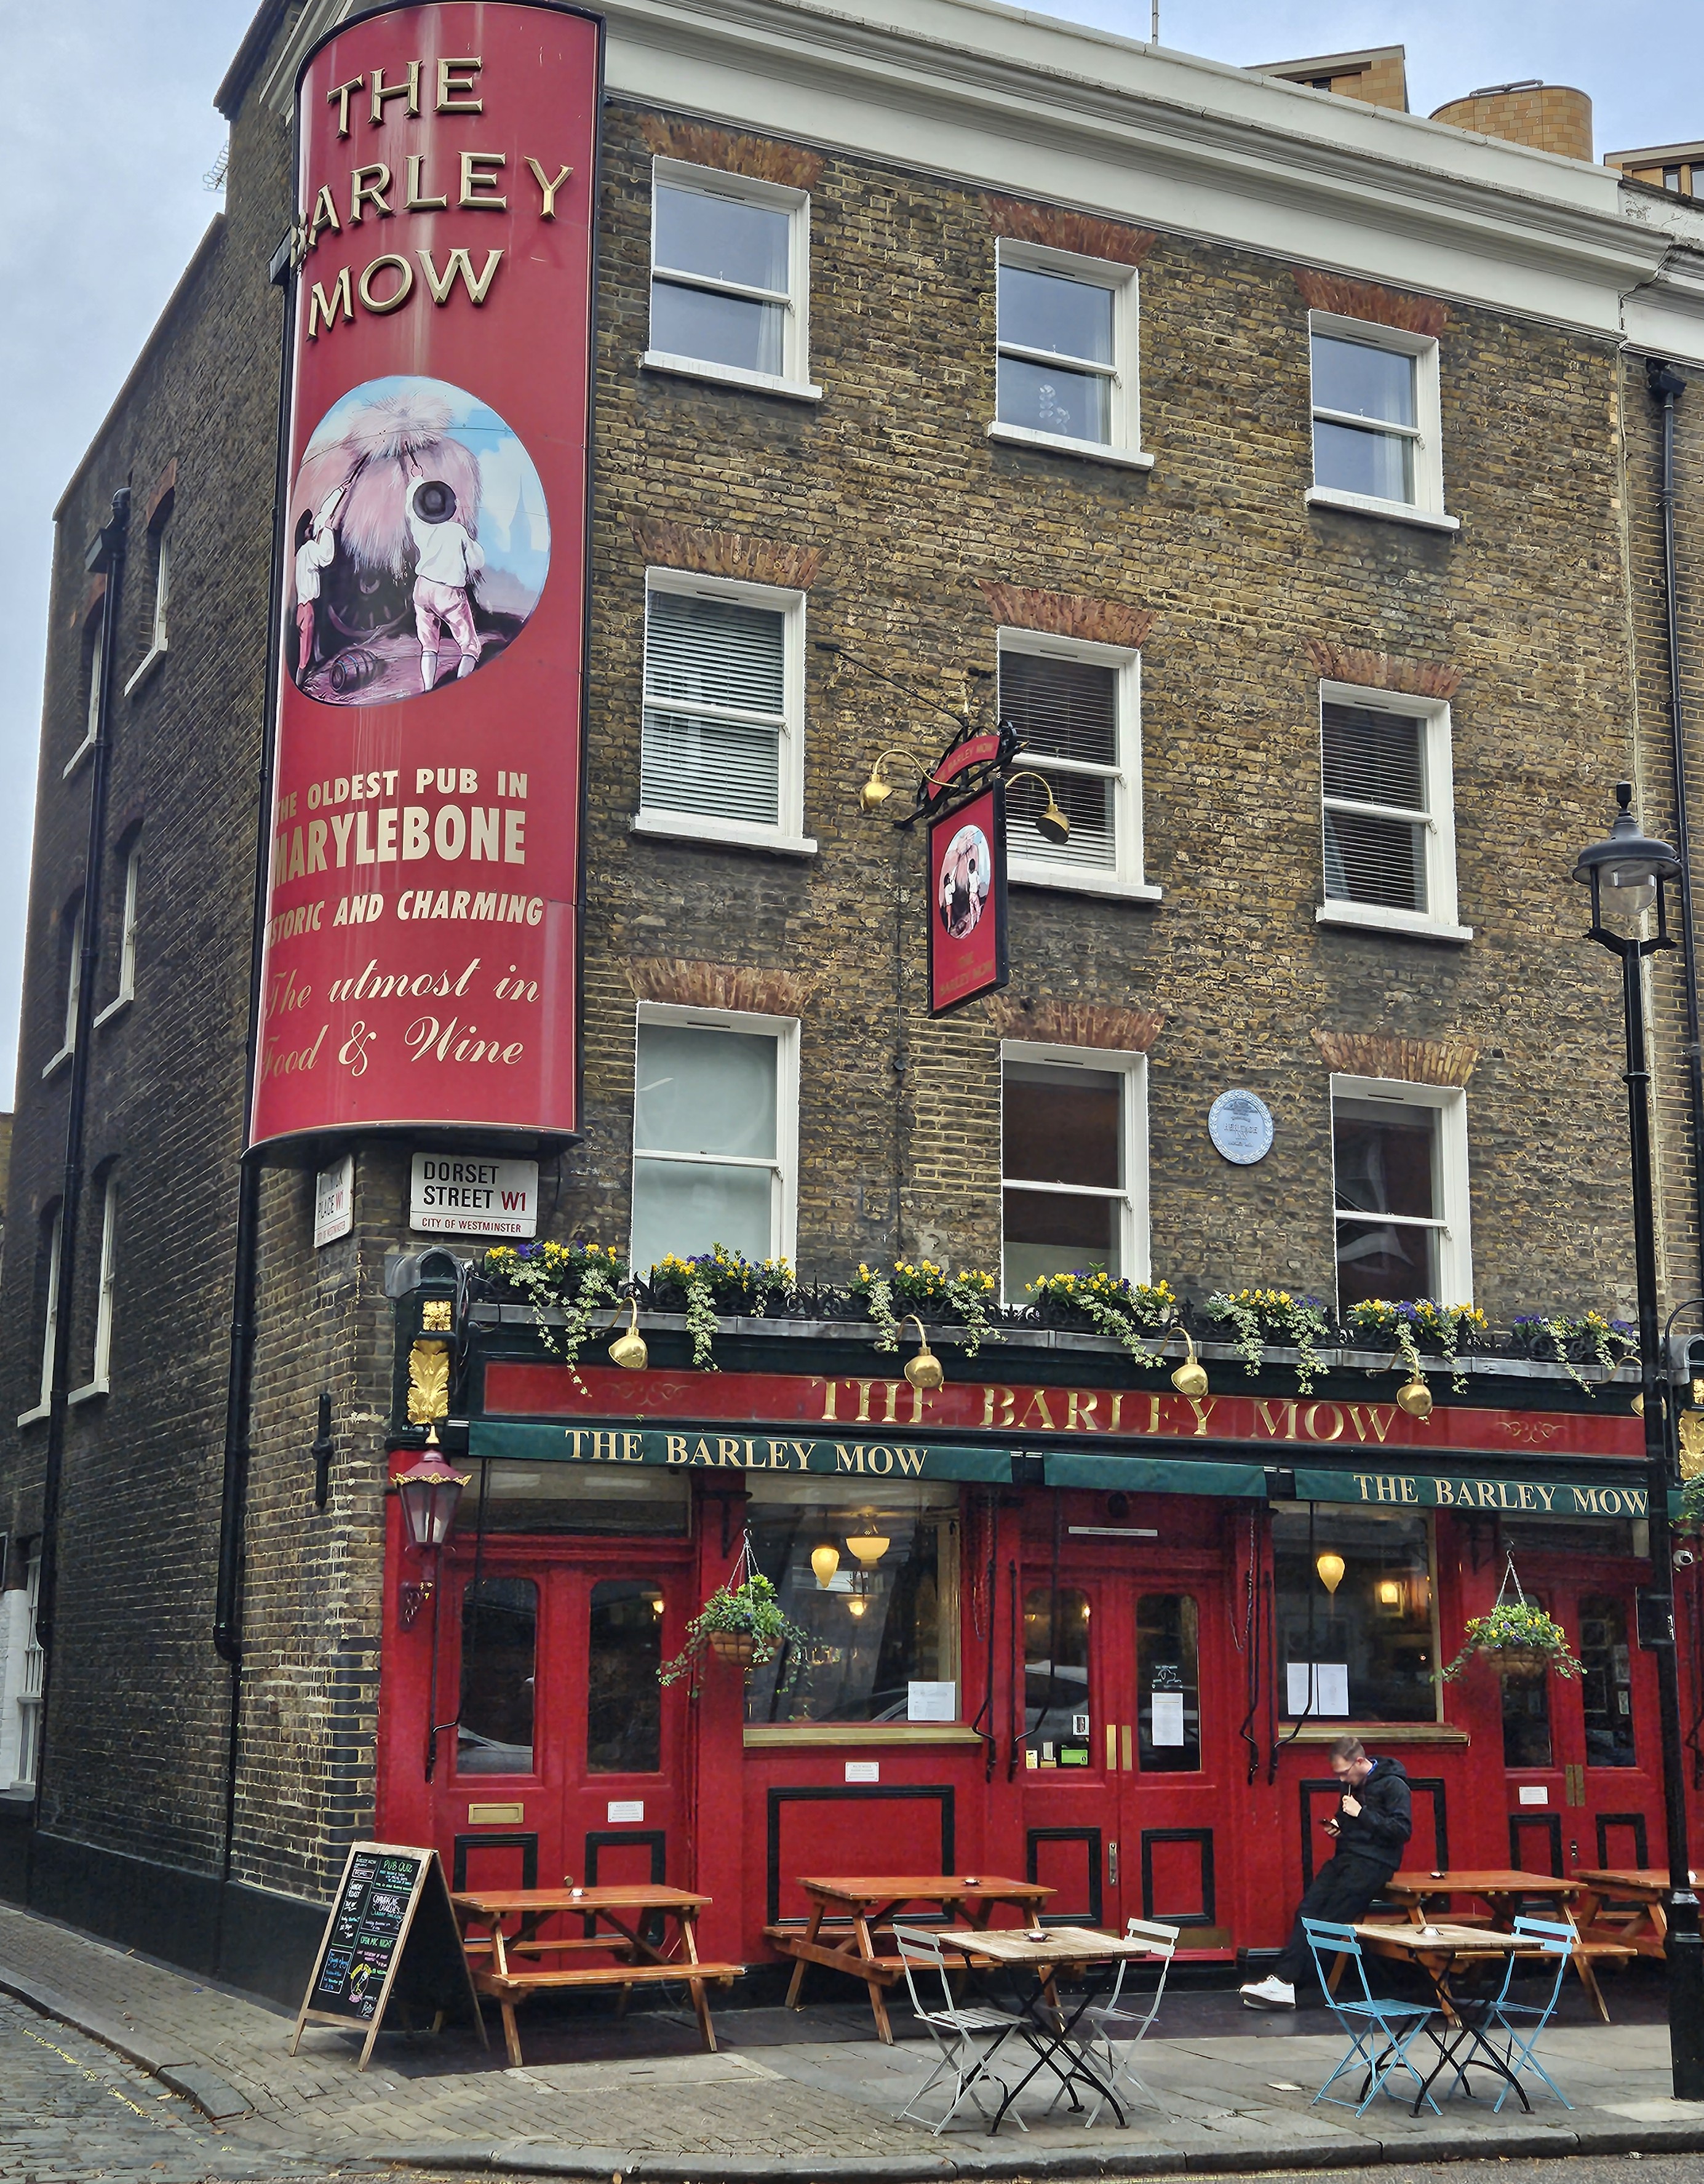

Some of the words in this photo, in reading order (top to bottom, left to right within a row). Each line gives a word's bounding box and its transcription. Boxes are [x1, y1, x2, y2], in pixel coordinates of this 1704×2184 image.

[327, 56, 483, 138] THE
[306, 249, 504, 340] MOW
[308, 770, 399, 810] OLDEST
[416, 768, 478, 794] PUB
[498, 770, 528, 799] IN
[272, 804, 526, 889] MARYLEBONE
[333, 892, 384, 927] AND
[397, 890, 544, 926] CHARMING
[266, 969, 311, 1021] The
[328, 958, 482, 1003] utmost
[493, 965, 540, 1002] in
[338, 1019, 378, 1077] &
[404, 1016, 524, 1066] Wine
[424, 1161, 499, 1185] DORSET
[317, 1195, 335, 1221] PLACE
[423, 1186, 495, 1209] STREET
[501, 1190, 526, 1211] W1
[422, 1218, 440, 1229] CITY
[445, 1219, 456, 1229] OF
[458, 1221, 522, 1233] WESTMINSTER
[811, 1379, 943, 1423] THE
[980, 1387, 1217, 1435] BARLEY
[1251, 1400, 1398, 1443] MOW
[565, 1429, 643, 1461] THE
[666, 1435, 816, 1471] BARLEY
[835, 1444, 928, 1477] MOW
[1353, 1475, 1419, 1504] THE
[1434, 1478, 1556, 1512] BARLEY
[1571, 1486, 1648, 1515] MOW
[383, 1859, 397, 1870] PUB
[398, 1861, 413, 1873] QUIZ
